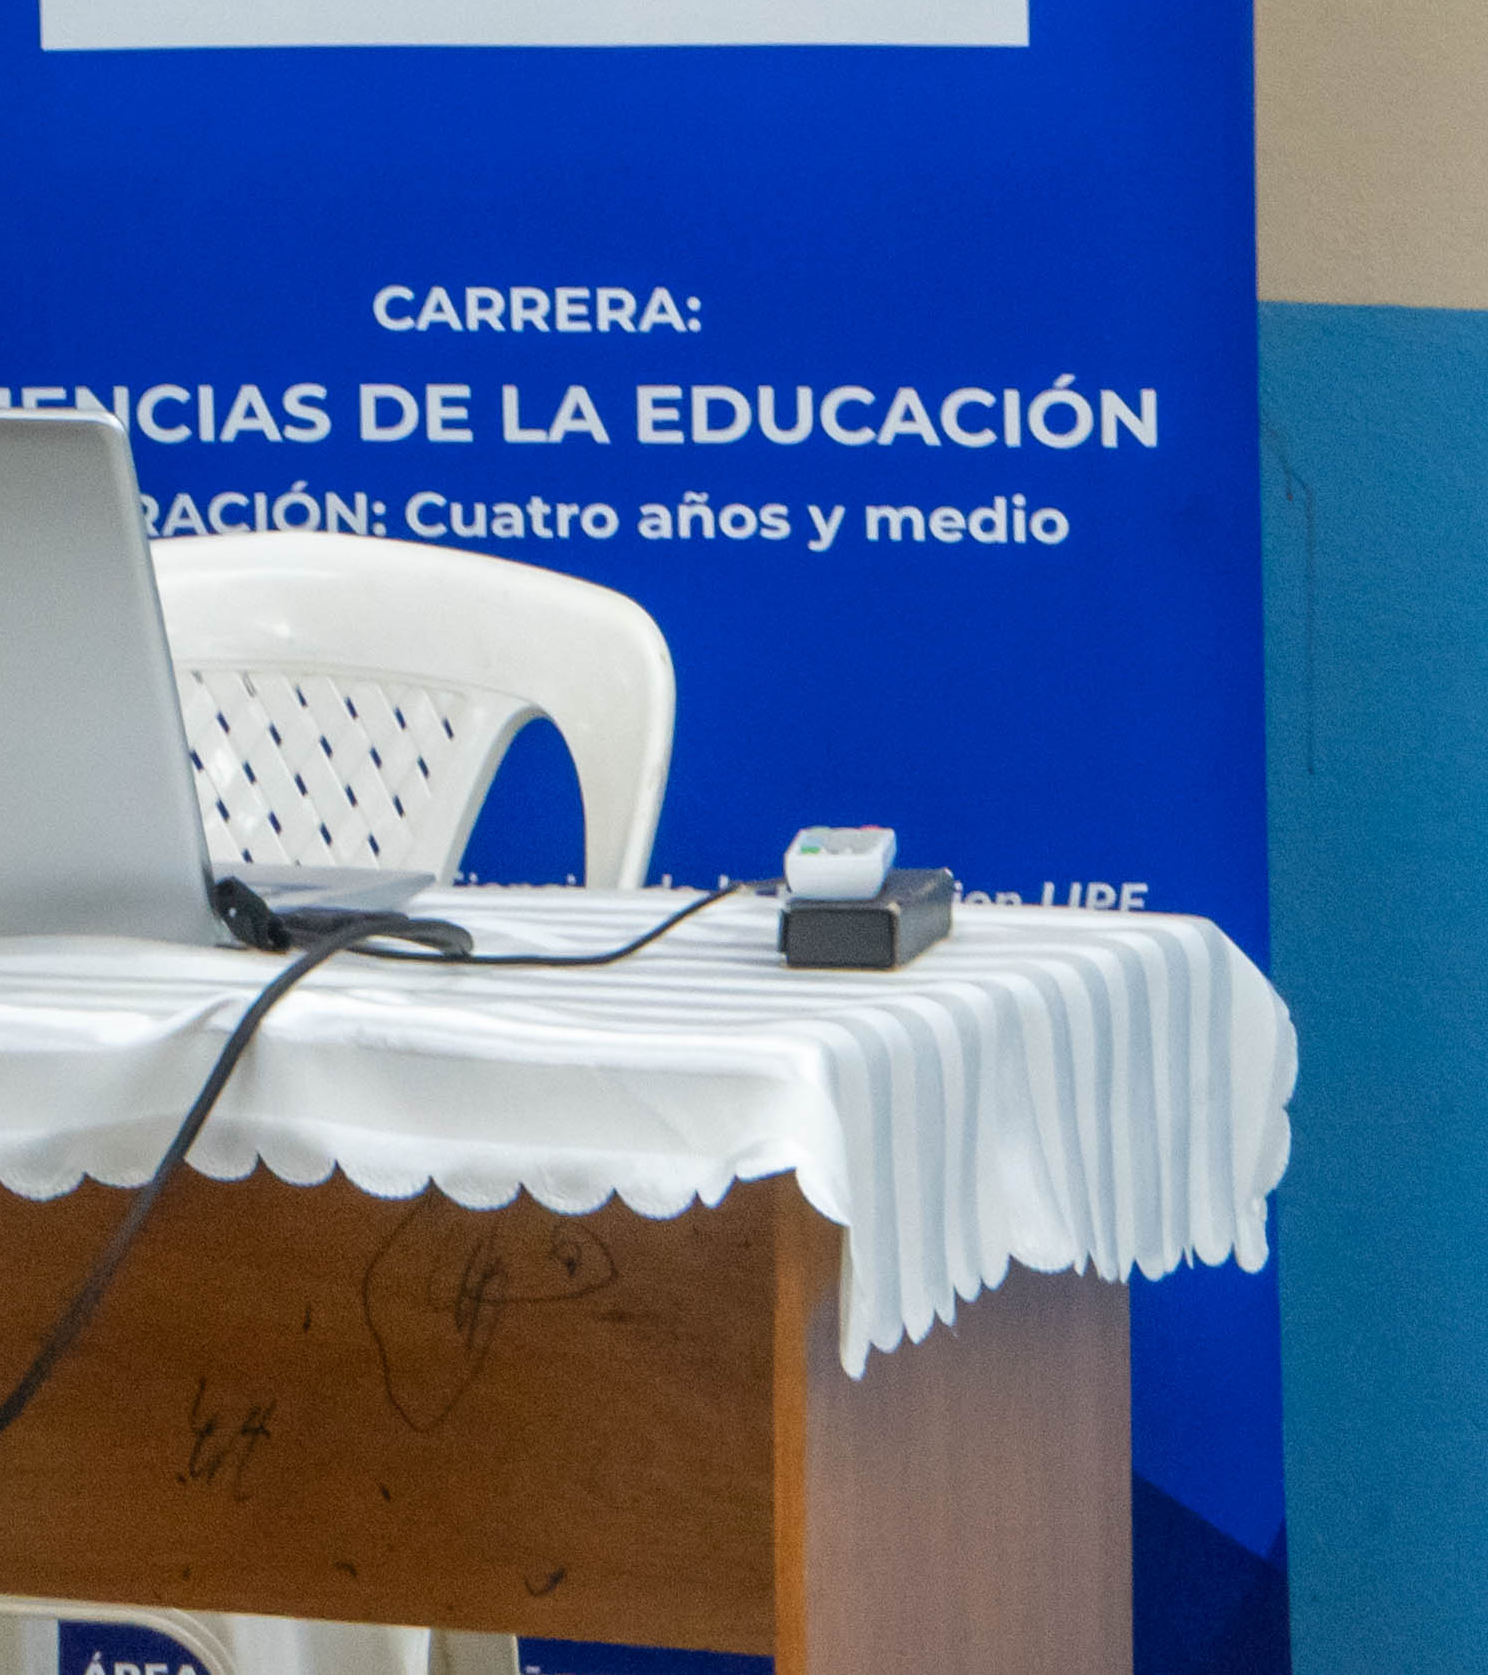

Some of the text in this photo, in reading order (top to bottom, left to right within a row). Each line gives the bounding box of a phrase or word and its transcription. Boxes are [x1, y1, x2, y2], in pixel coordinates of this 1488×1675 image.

[372, 285, 702, 333] CARRERA:
[359, 383, 474, 443] DE
[501, 384, 611, 445] LA
[636, 373, 1158, 450] EDUCACIÓN
[137, 480, 1070, 553] RACIÓN: Cuatro años y medio
